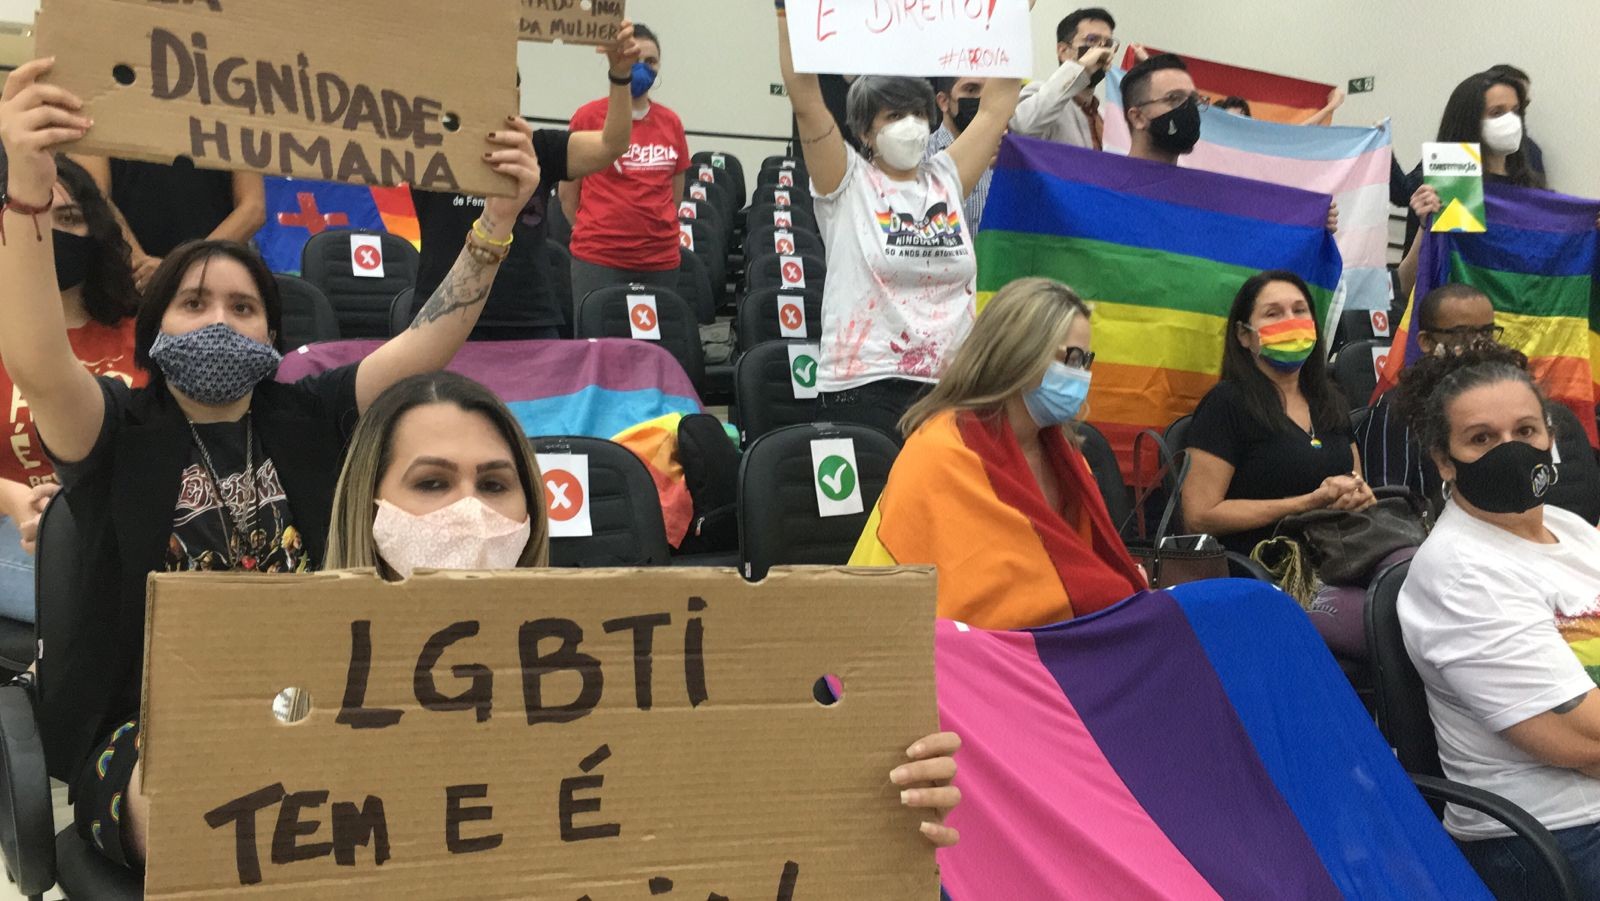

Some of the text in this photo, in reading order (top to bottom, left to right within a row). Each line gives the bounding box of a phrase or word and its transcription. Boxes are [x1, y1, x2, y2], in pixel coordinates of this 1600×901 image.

[189, 116, 460, 189] HUMANA
[203, 744, 621, 885] TEM E É
